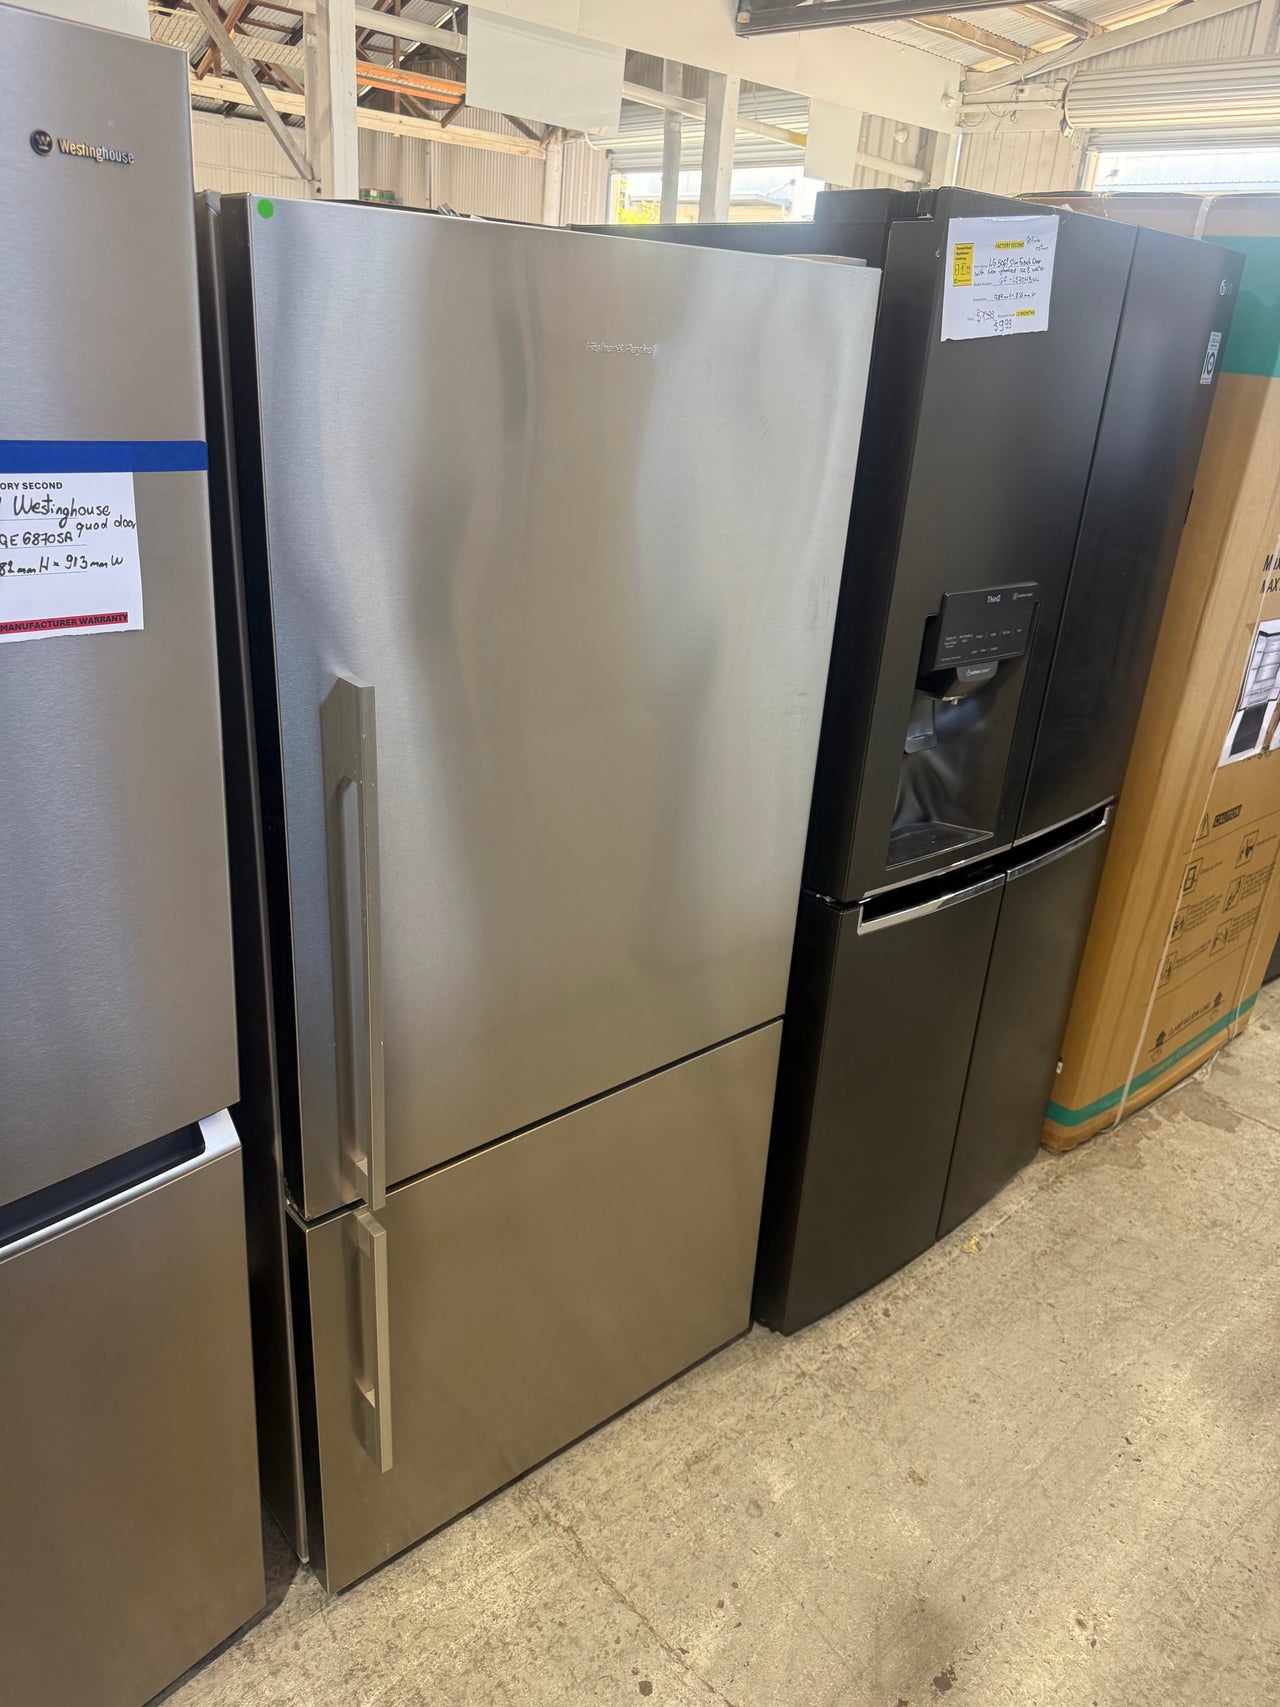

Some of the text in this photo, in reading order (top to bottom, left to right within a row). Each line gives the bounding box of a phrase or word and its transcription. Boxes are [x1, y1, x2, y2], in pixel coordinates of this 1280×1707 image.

[57, 138, 135, 164] Westinghouse
[22, 481, 63, 490] SECOND
[13, 493, 111, 529] Westinghouse
[0, 613, 128, 633] MANUFACTURER WARRANTY
[1213, 805, 1240, 827] CAUTION
